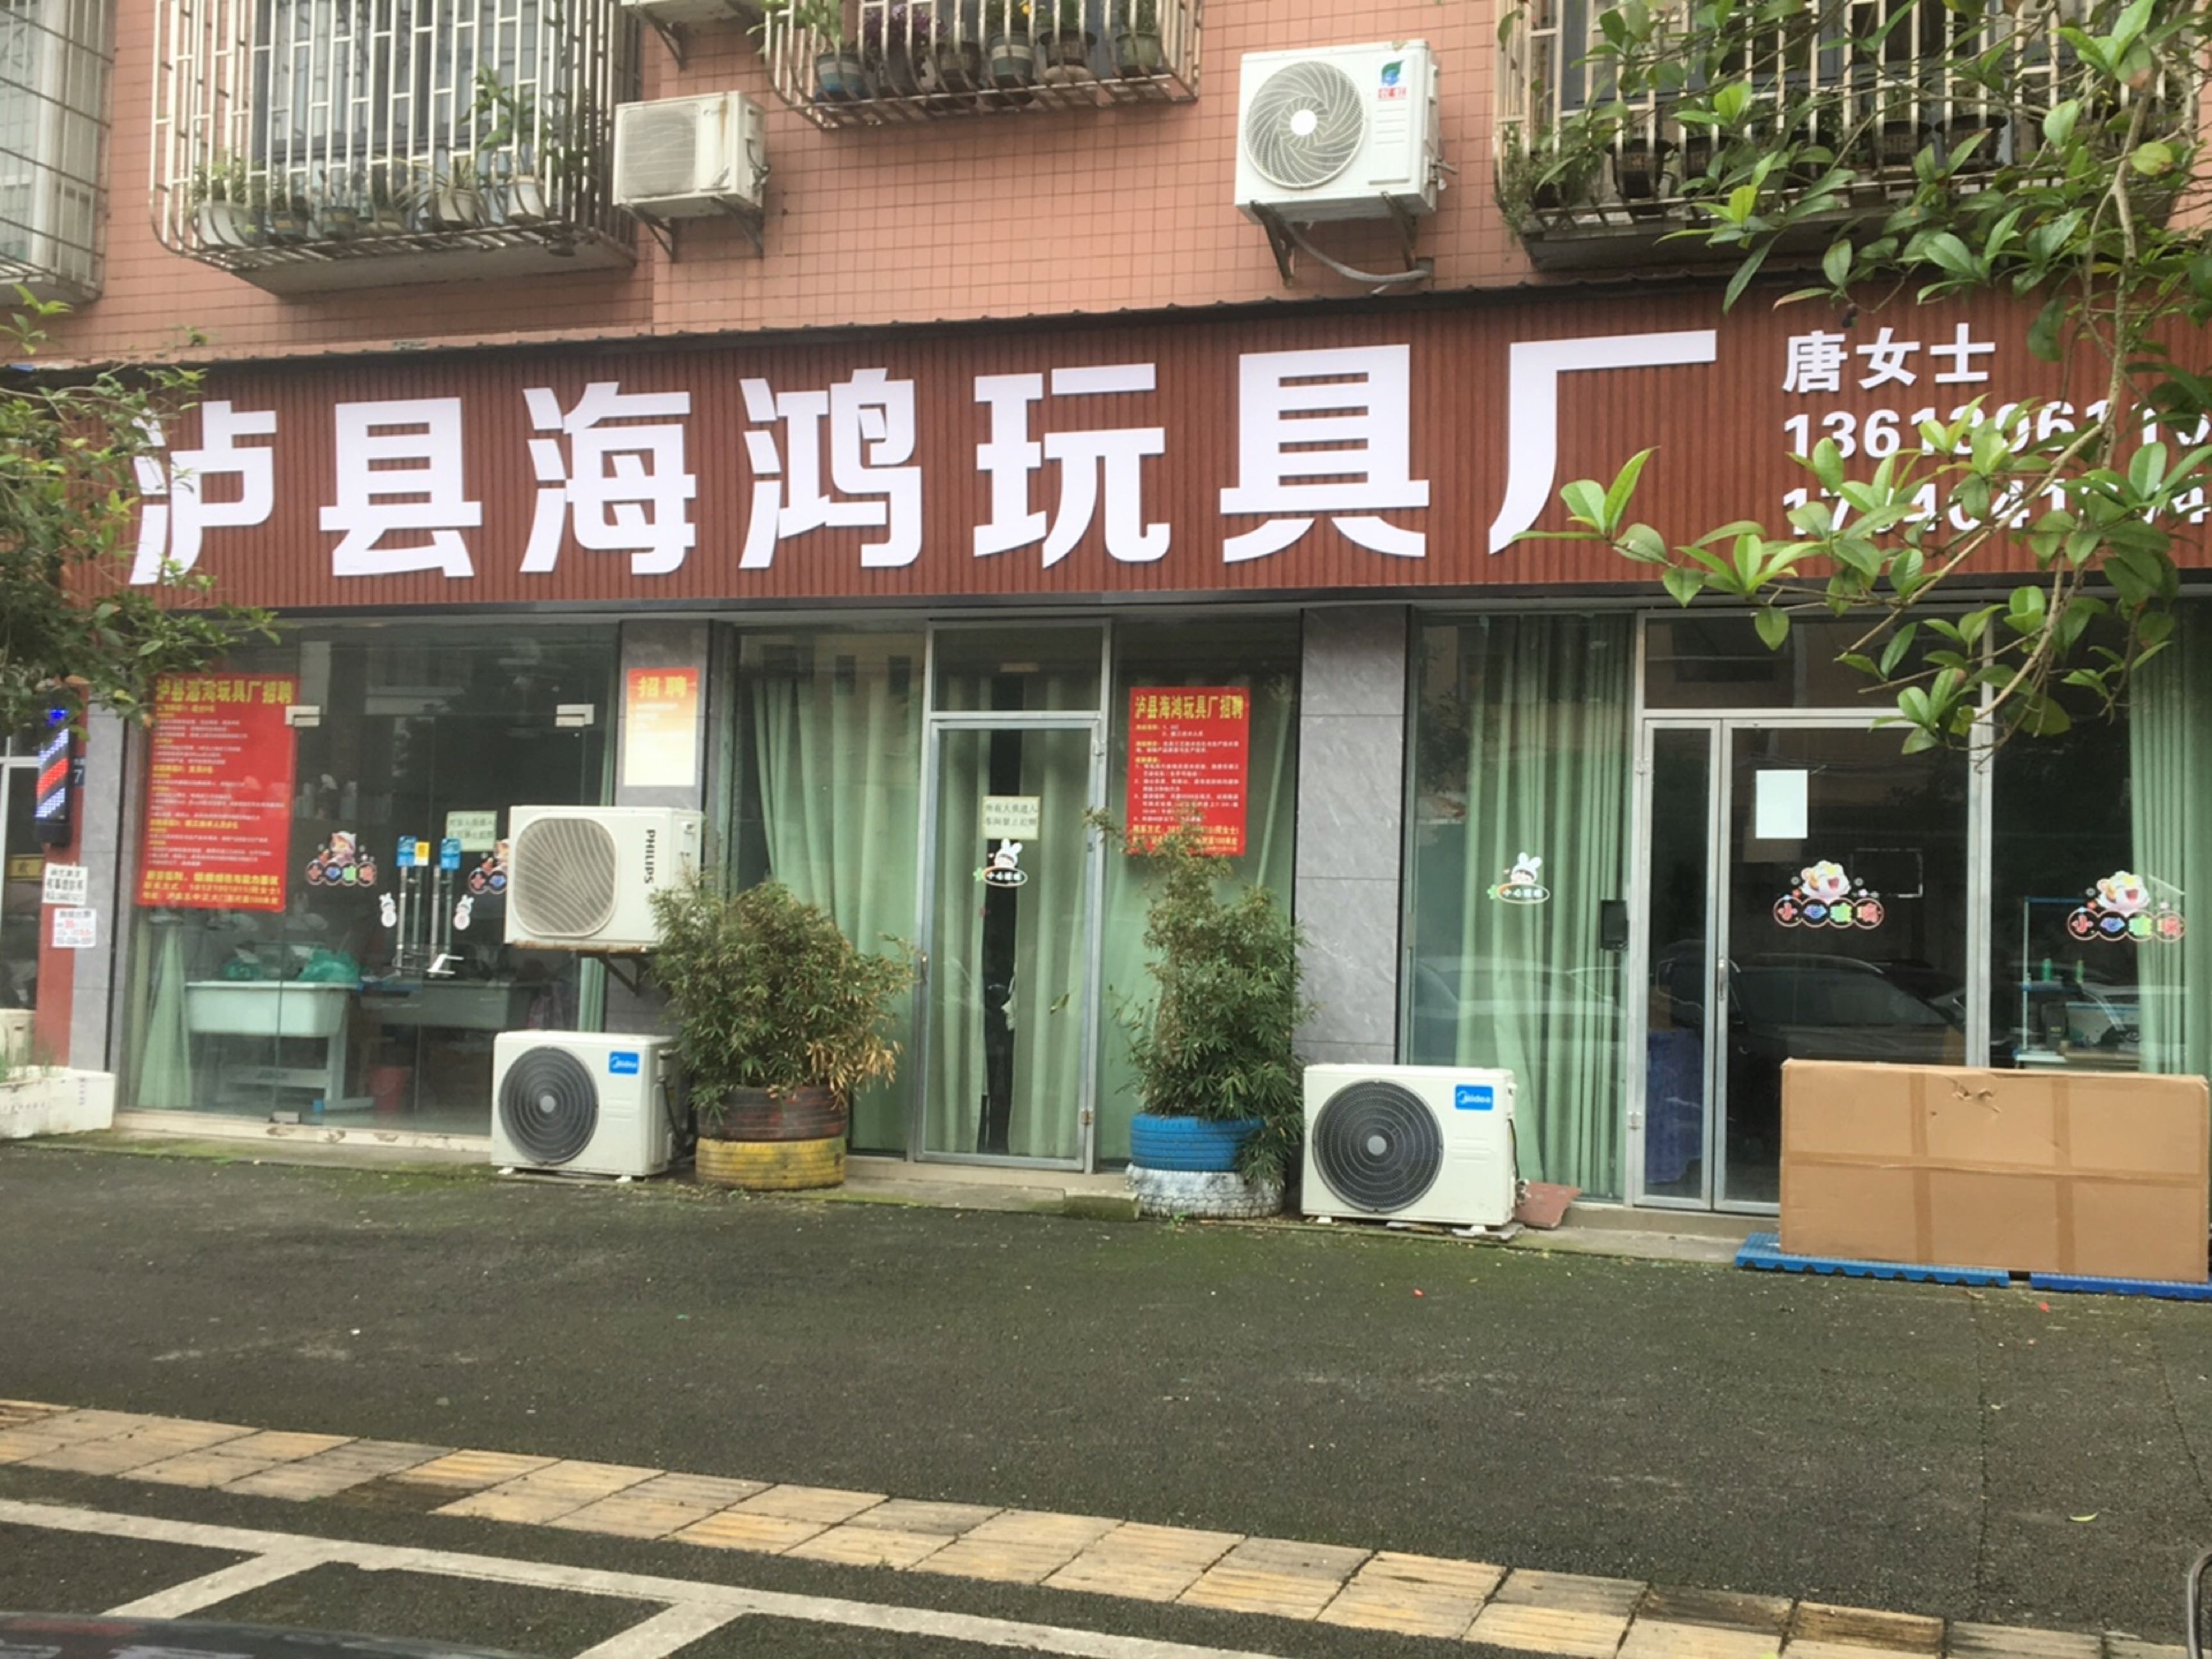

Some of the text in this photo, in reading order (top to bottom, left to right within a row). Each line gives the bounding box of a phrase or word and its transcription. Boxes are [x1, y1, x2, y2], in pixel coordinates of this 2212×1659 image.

[1783, 323, 1996, 394] 唐女士
[129, 329, 1717, 586] 泸县海鸿玩具厂
[638, 676, 687, 698] 招聘
[644, 829, 655, 884] PHILIPS
[1457, 1091, 1491, 1104] Midea
